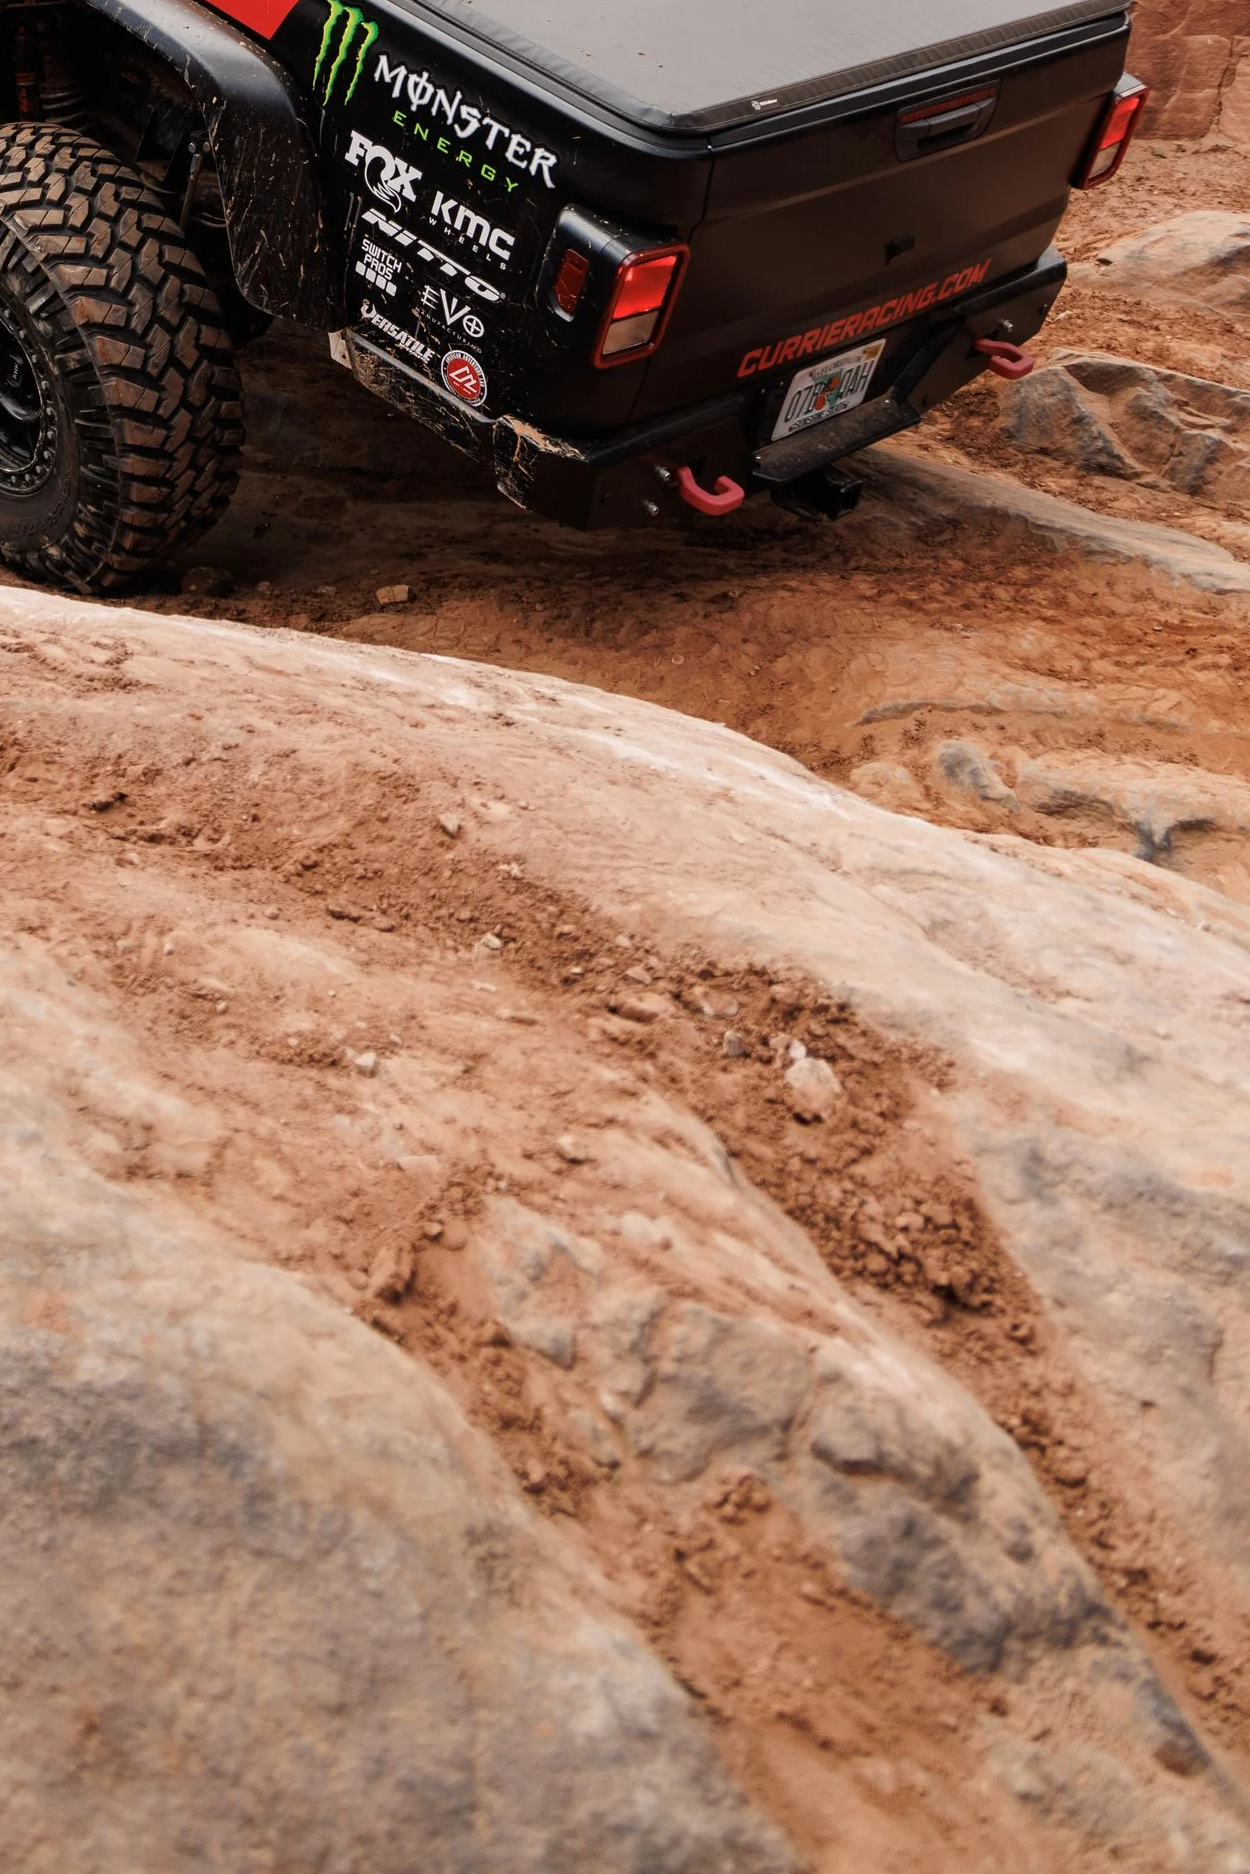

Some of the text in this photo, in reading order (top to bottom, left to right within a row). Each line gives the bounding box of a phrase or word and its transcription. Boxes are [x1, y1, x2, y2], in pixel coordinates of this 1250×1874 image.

[373, 55, 556, 189] MONSTER
[392, 110, 519, 193] ENERGY
[344, 129, 423, 213] FOX
[361, 207, 500, 302] NITTO
[361, 239, 402, 274] SWITCH
[363, 253, 394, 281] PROS
[429, 217, 508, 270] WHEELS
[360, 300, 436, 363] VERSATILE
[737, 258, 992, 378] CURRIERACING.COM
